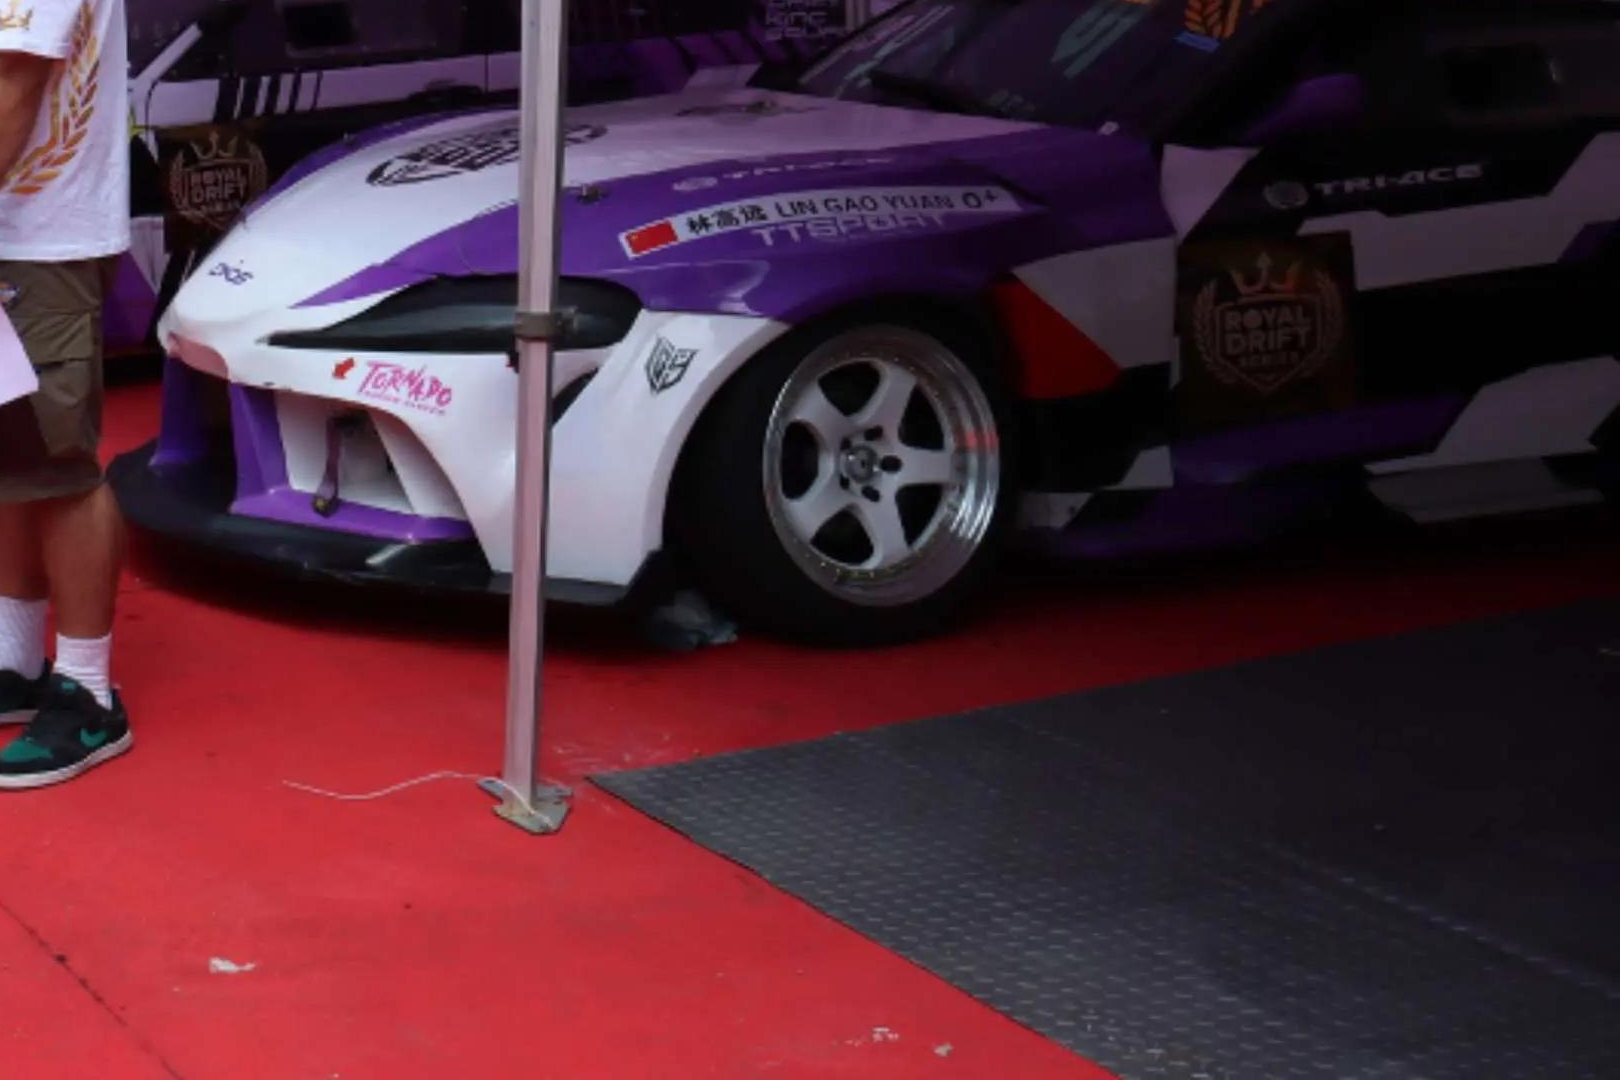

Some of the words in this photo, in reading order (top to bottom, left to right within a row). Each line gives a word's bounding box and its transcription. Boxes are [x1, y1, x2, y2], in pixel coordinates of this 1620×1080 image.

[191, 179, 247, 204] DRIFT
[775, 198, 818, 218] LIN
[824, 195, 878, 214] GAO
[882, 194, 955, 210] YUAN
[1224, 305, 1311, 331] ROYAL
[1224, 325, 1312, 355] DRIFT
